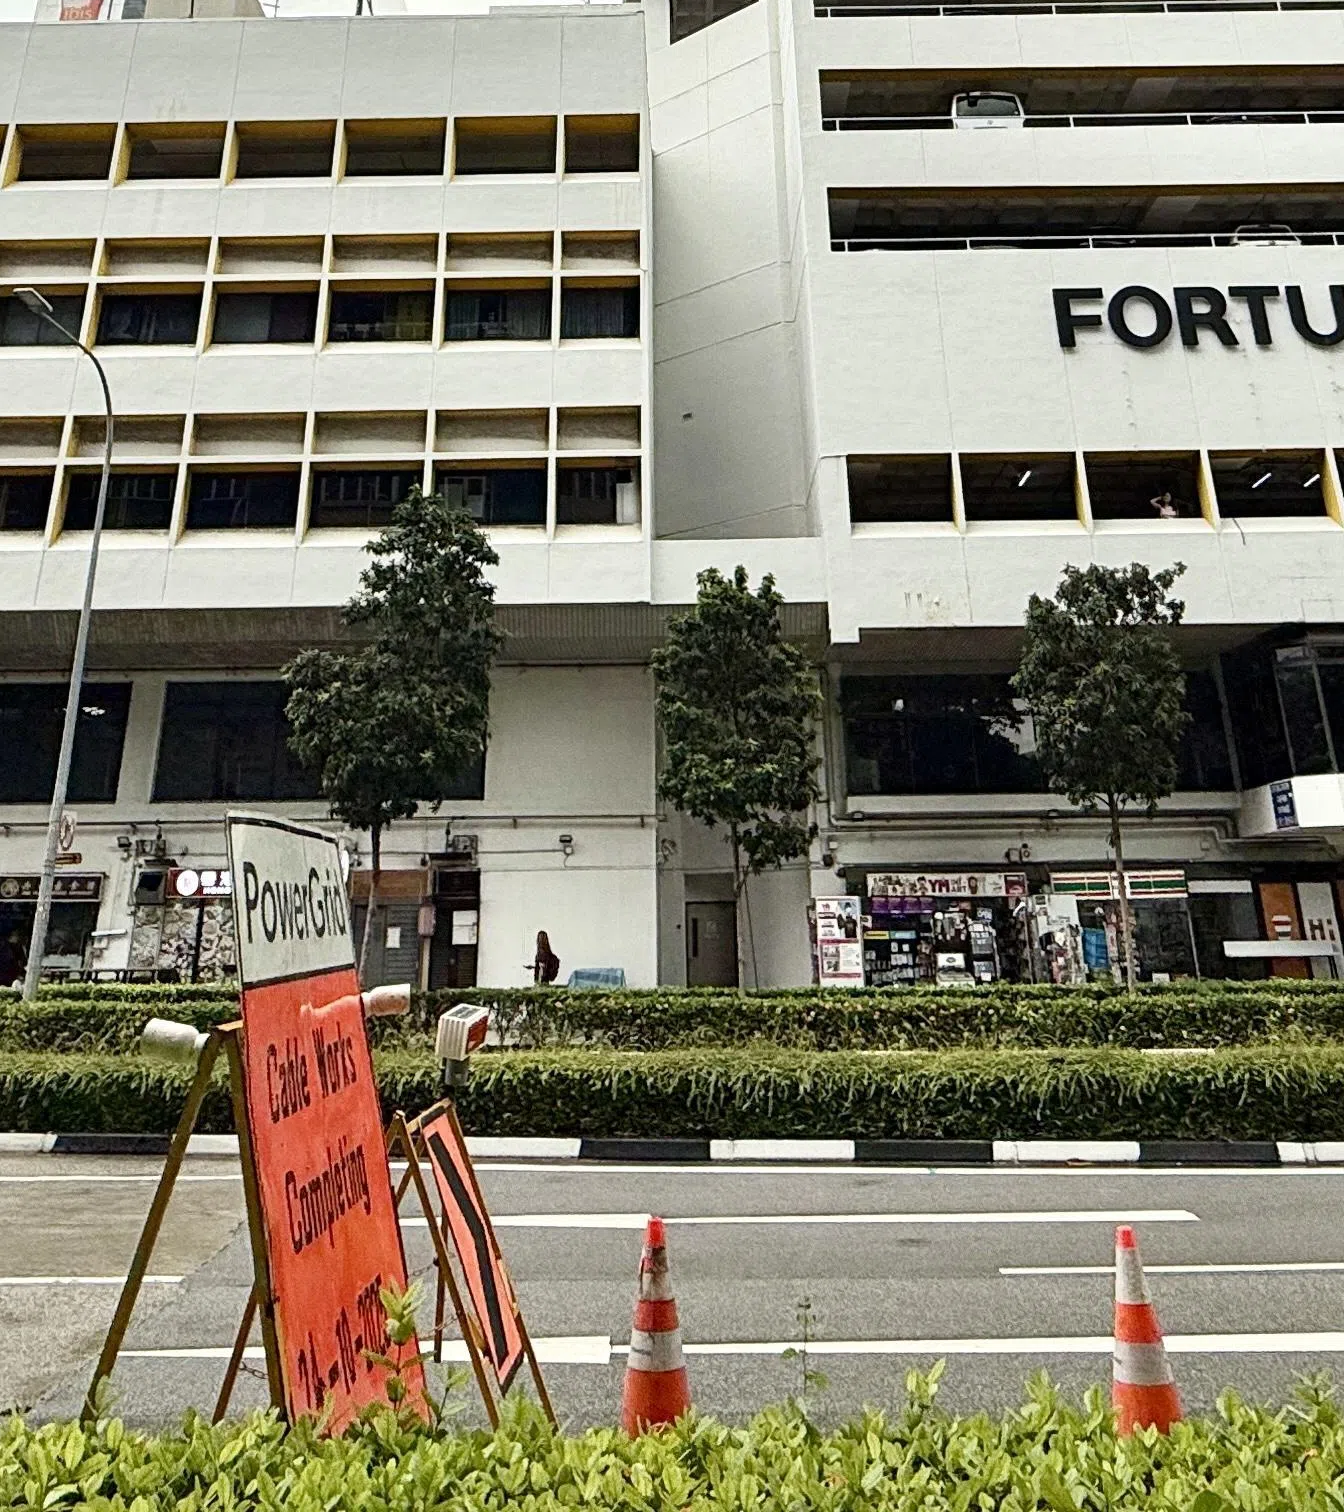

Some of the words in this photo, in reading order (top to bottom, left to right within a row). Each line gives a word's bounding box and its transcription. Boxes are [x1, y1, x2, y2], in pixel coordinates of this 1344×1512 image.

[242, 861, 347, 944] PowerGrid
[266, 1037, 311, 1124] Cable
[312, 1021, 357, 1099] Works
[285, 1135, 372, 1255] Completing
